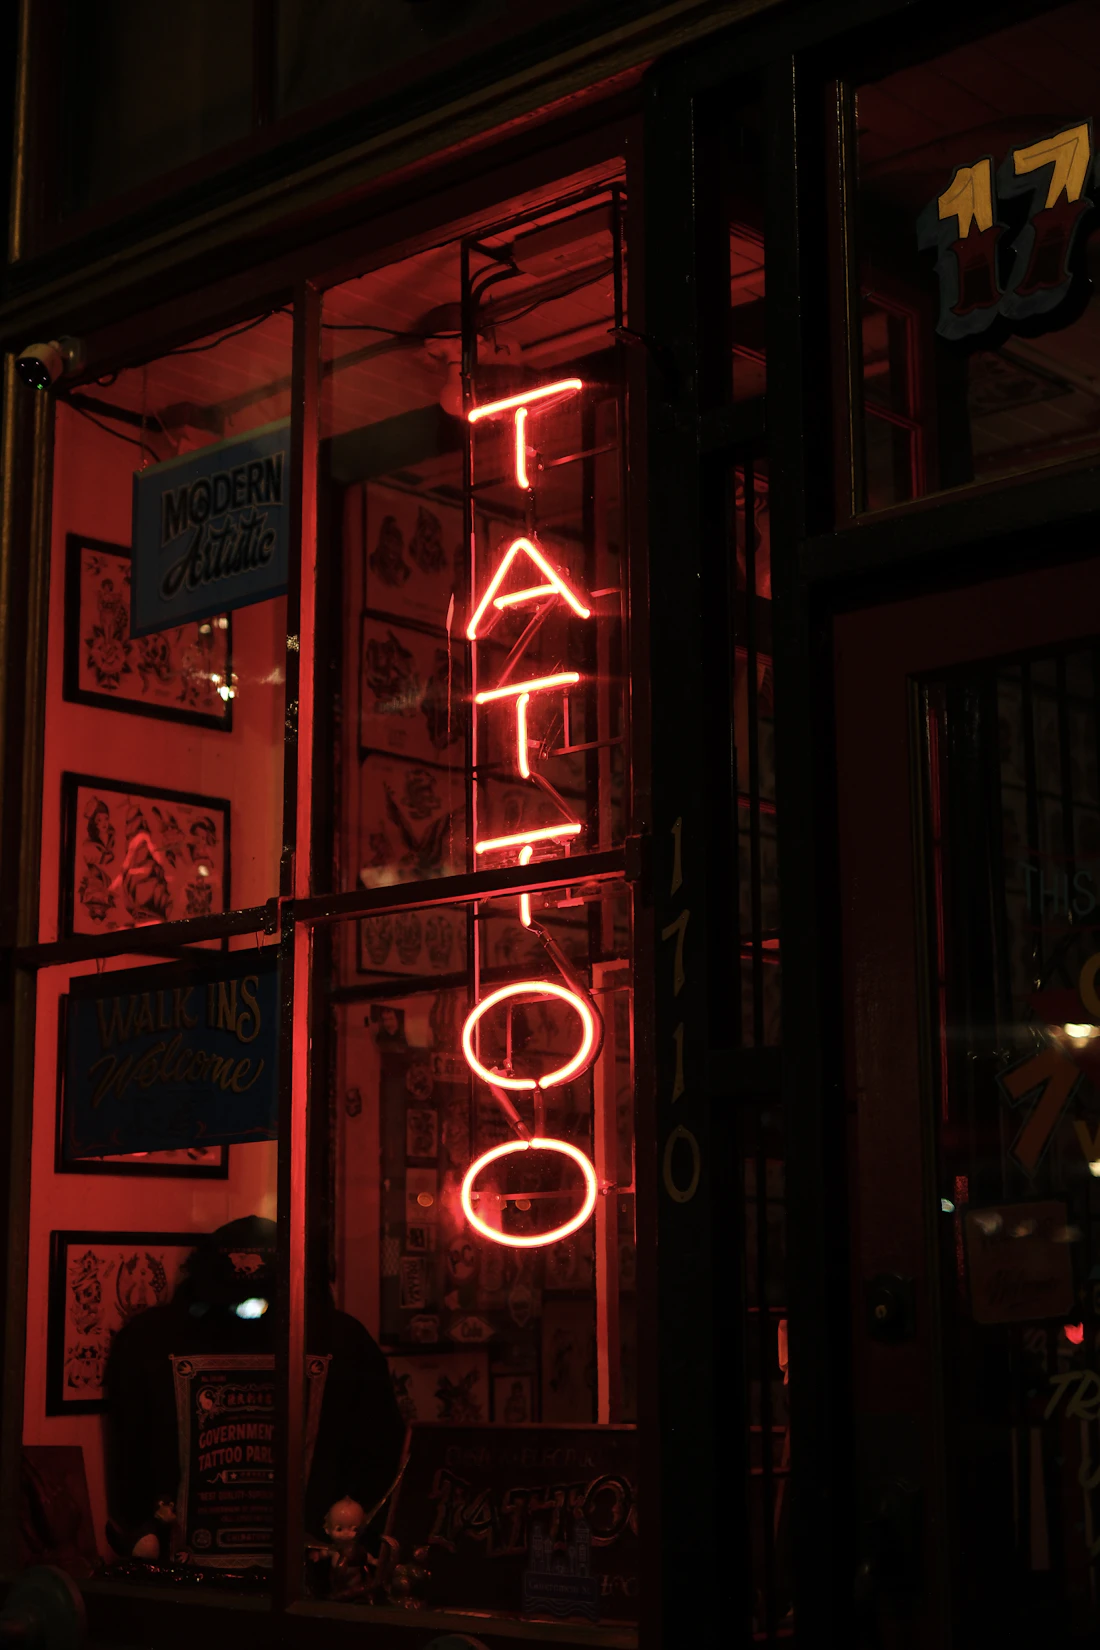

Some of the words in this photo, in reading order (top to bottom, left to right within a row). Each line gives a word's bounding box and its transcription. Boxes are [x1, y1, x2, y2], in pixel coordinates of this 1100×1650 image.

[161, 451, 284, 547] MODERN
[160, 508, 277, 600] Artistic
[464, 377, 600, 1250] TATTOO
[1018, 861, 1096, 917] THIS
[96, 986, 198, 1050] WALK
[206, 975, 262, 1043] INS
[661, 815, 701, 1203] 1710
[87, 1033, 265, 1108] Welcome
[198, 1446, 242, 1472] TATTOO
[199, 1423, 274, 1449] GOVERNMEN
[427, 1466, 640, 1559] TATTO
